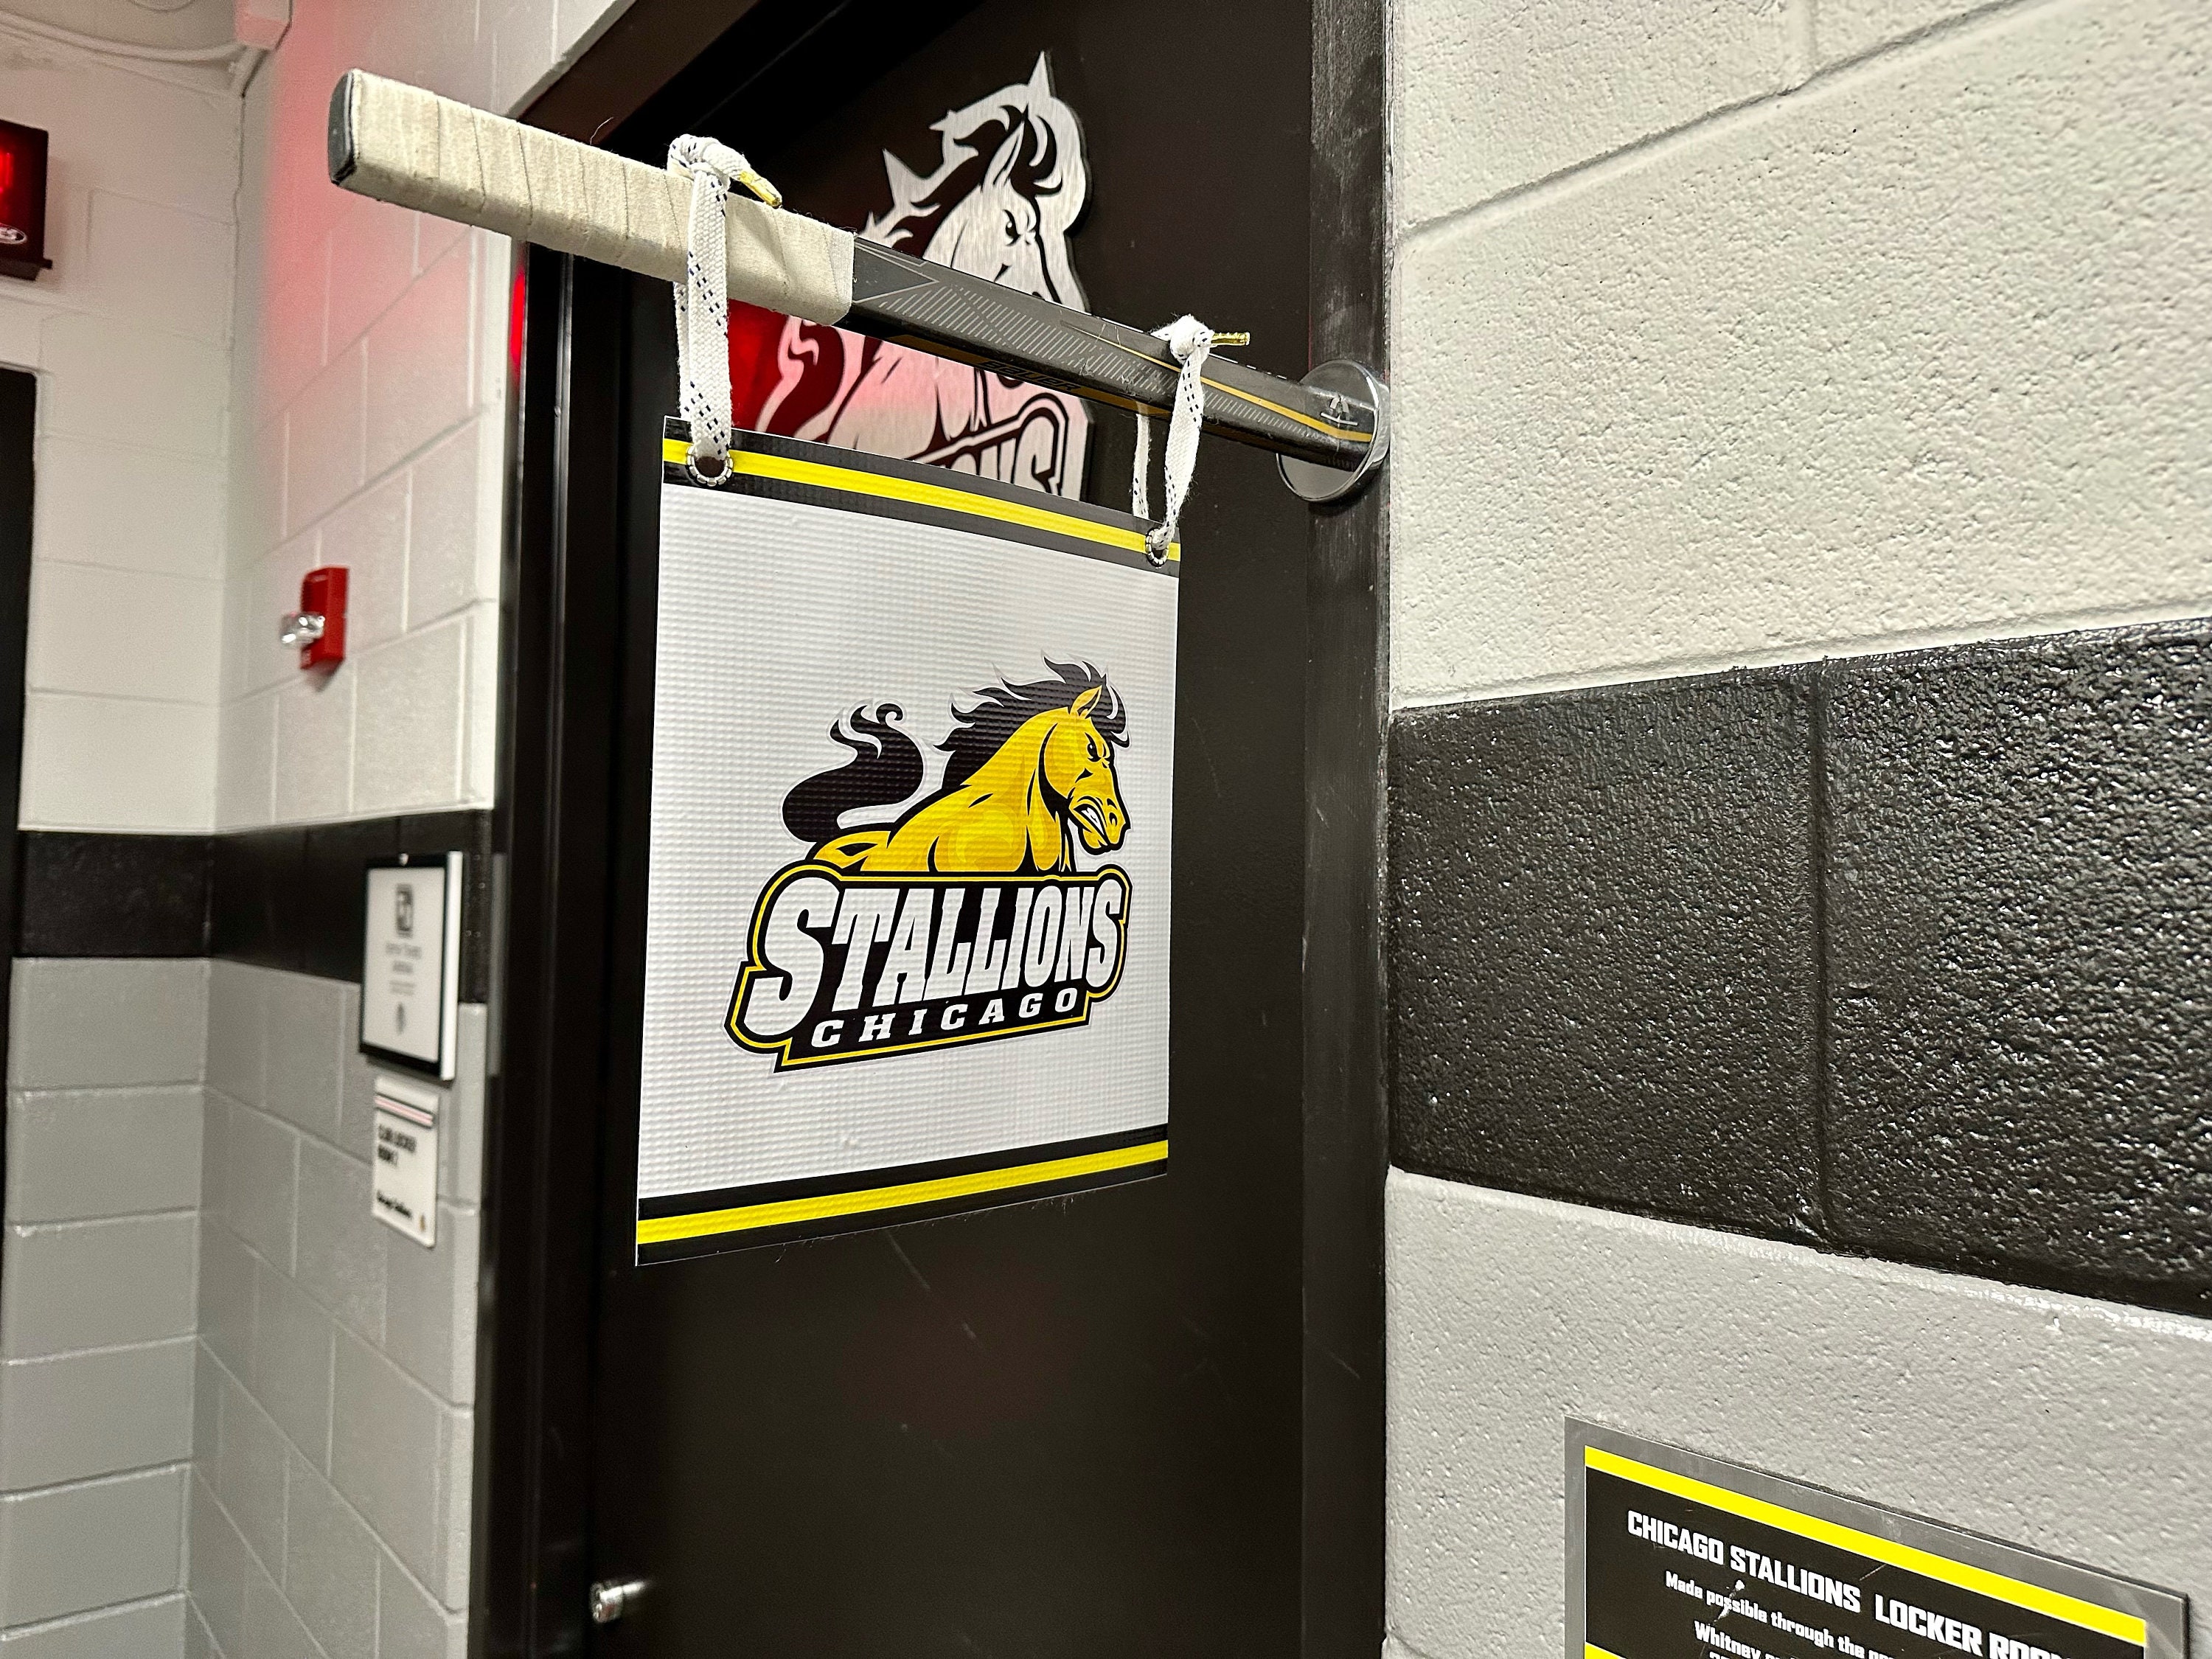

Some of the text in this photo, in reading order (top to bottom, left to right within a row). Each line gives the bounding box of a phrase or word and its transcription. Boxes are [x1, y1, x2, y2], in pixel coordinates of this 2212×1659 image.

[743, 876, 1124, 1036] STALLIONS
[810, 987, 1078, 1048] CHICAGO
[1627, 1510, 2070, 1659] CHICAGO STALLIONS LOCKER RO
[1666, 1571, 1865, 1659] Made possible through the
[1694, 1620, 1761, 1659] Whitney
